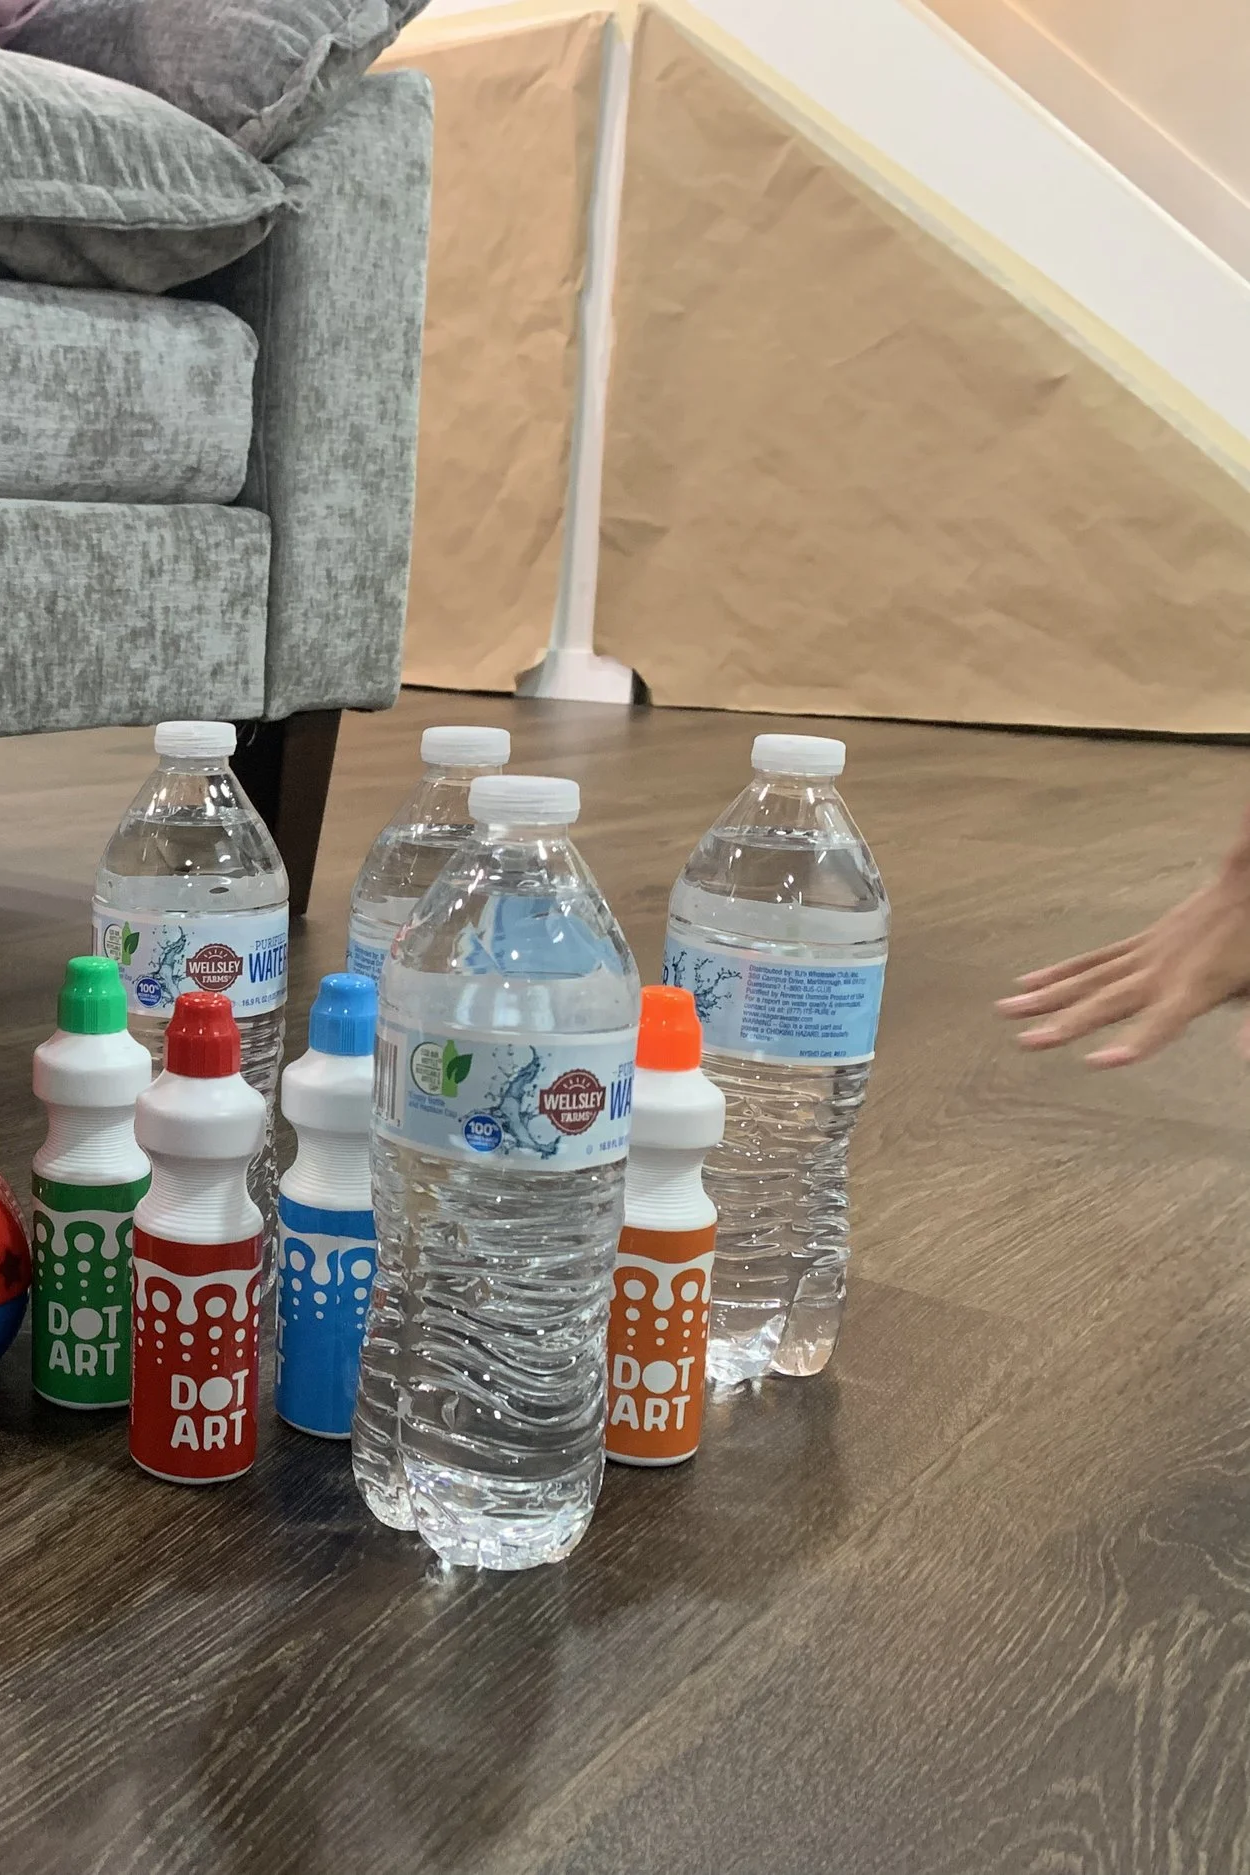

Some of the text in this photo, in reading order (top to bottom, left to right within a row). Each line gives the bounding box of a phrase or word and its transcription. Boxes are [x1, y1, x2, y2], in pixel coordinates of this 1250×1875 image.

[189, 961, 241, 975] WELLSLEY
[242, 998, 254, 1007] 16.9
[543, 1091, 603, 1110] WELLSLEY
[48, 1300, 123, 1340] DOT
[49, 1340, 121, 1376] ART
[612, 1353, 695, 1395] DOT
[170, 1368, 250, 1412] DOT
[170, 1408, 247, 1451] ART
[610, 1394, 691, 1432] ART
